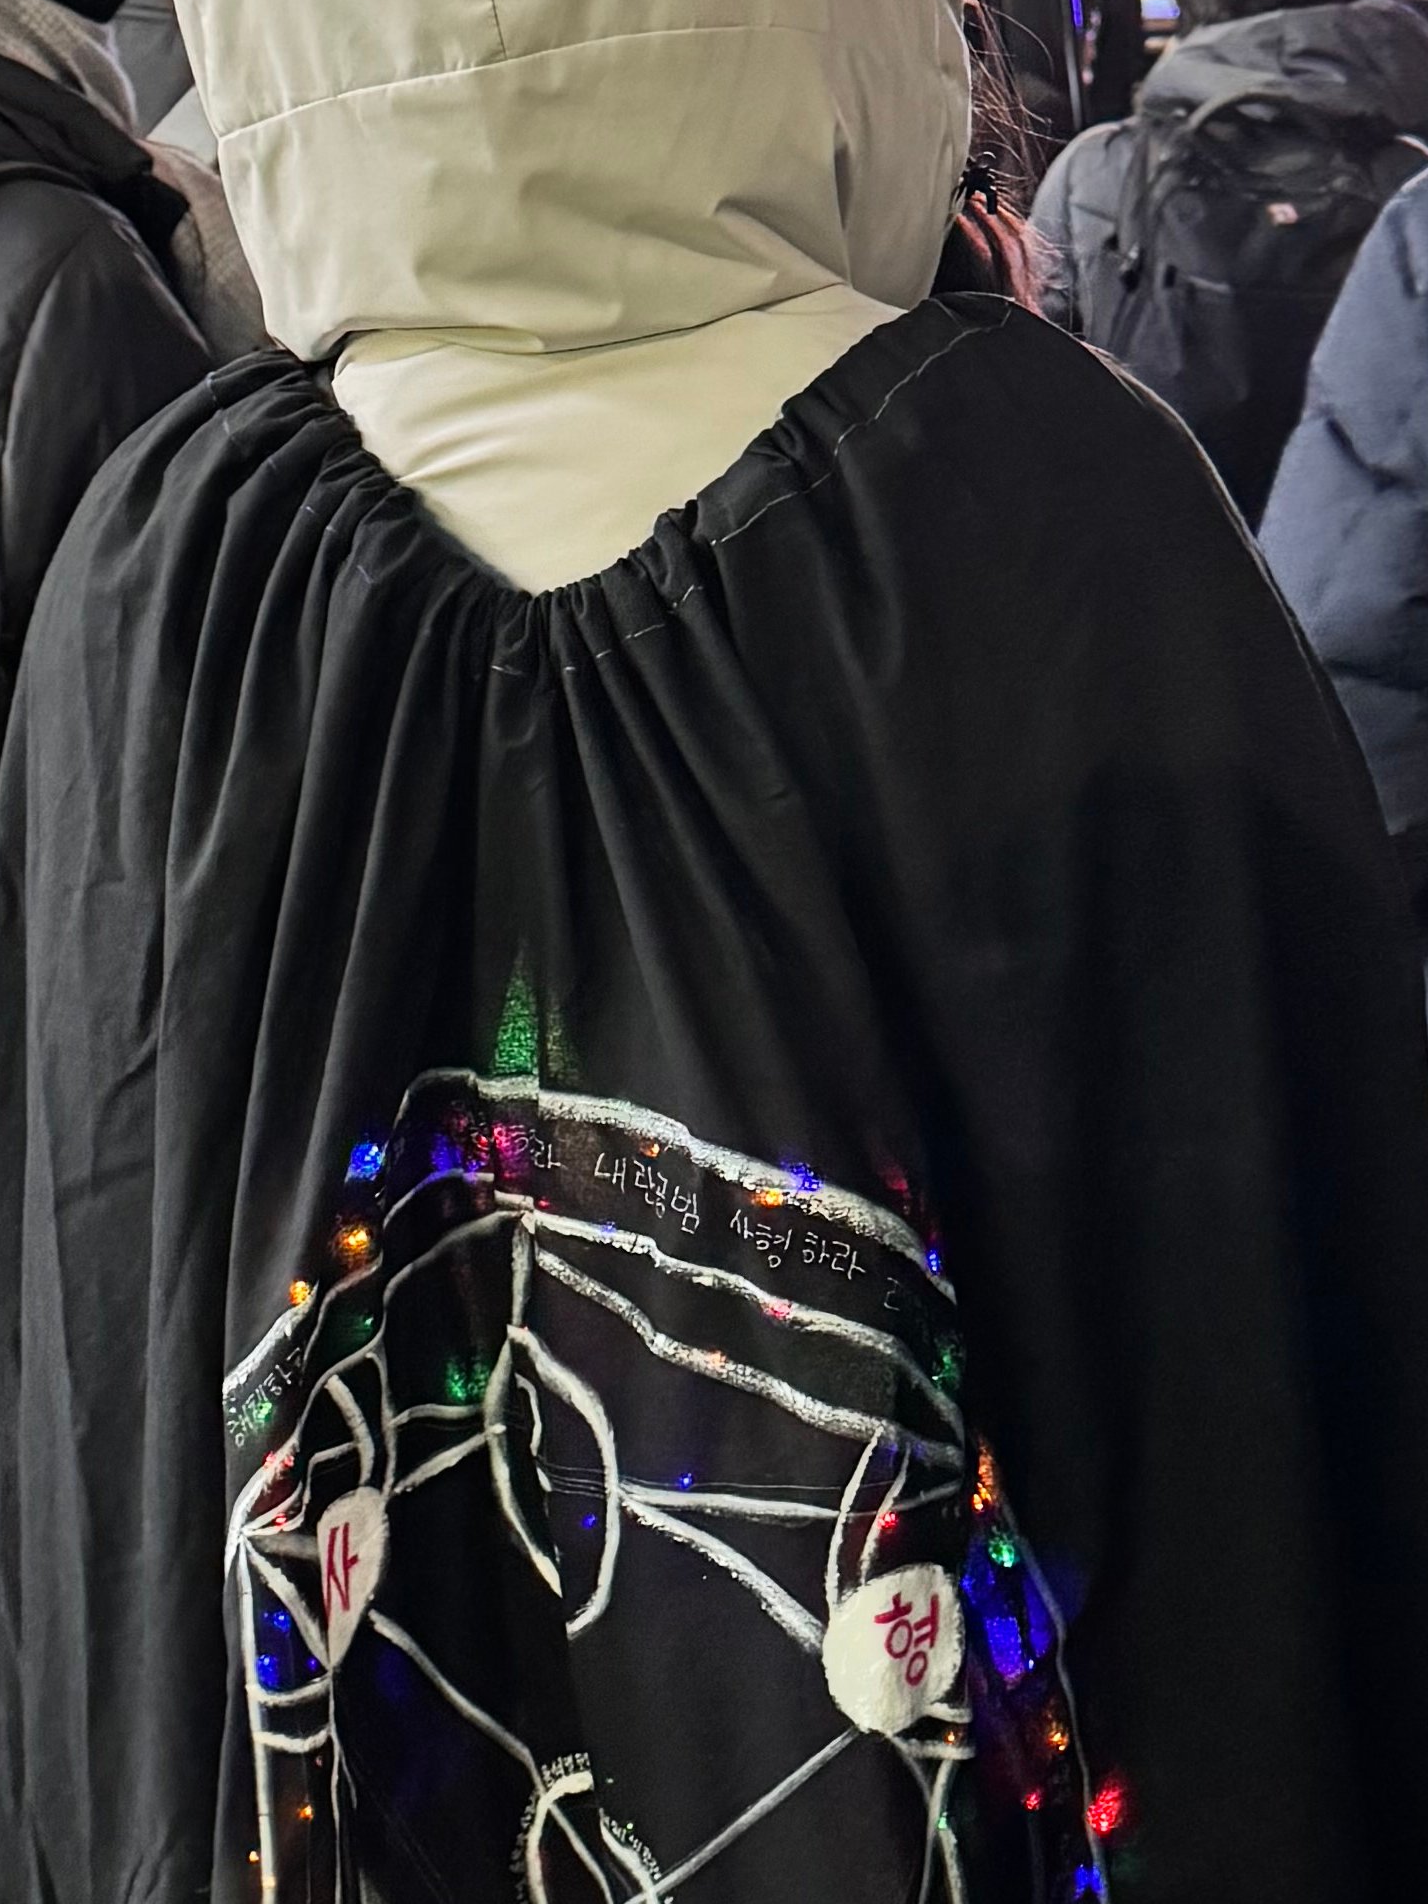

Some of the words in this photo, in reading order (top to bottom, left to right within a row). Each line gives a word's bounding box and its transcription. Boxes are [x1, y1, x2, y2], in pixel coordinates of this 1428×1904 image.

[593, 1152, 701, 1235] 내란공범
[324, 1524, 359, 1624] 사
[874, 1593, 941, 1688] 형
